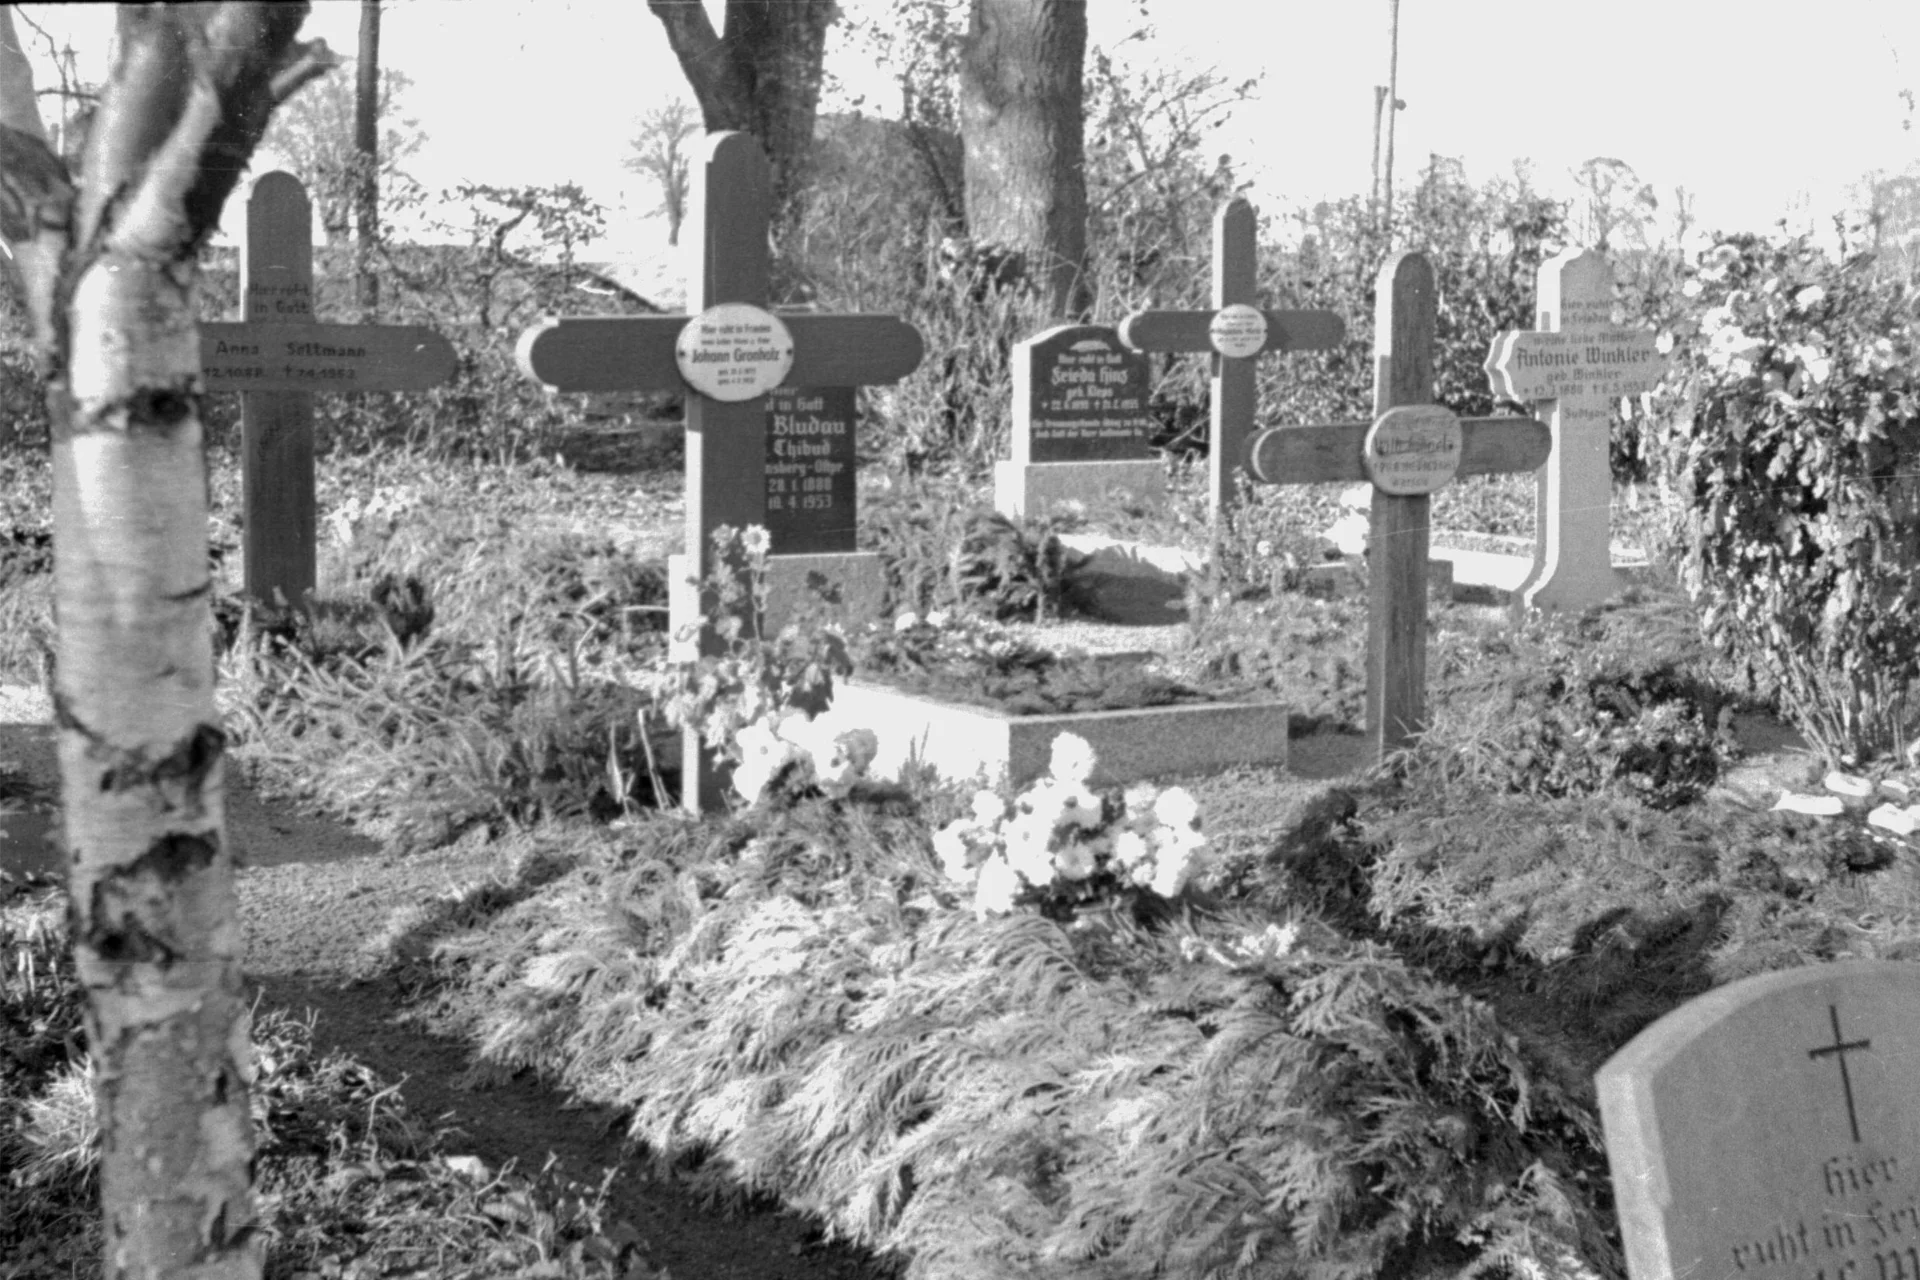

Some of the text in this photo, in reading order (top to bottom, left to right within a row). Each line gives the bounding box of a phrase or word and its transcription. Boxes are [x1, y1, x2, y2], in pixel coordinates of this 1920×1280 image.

[215, 340, 260, 355] Anna
[692, 348, 730, 363] Johann
[1516, 345, 1651, 370] Antonie Winkler
[772, 414, 847, 436] Bludau
[1730, 1220, 1810, 1271] ruht
[1821, 1214, 1857, 1249] in
